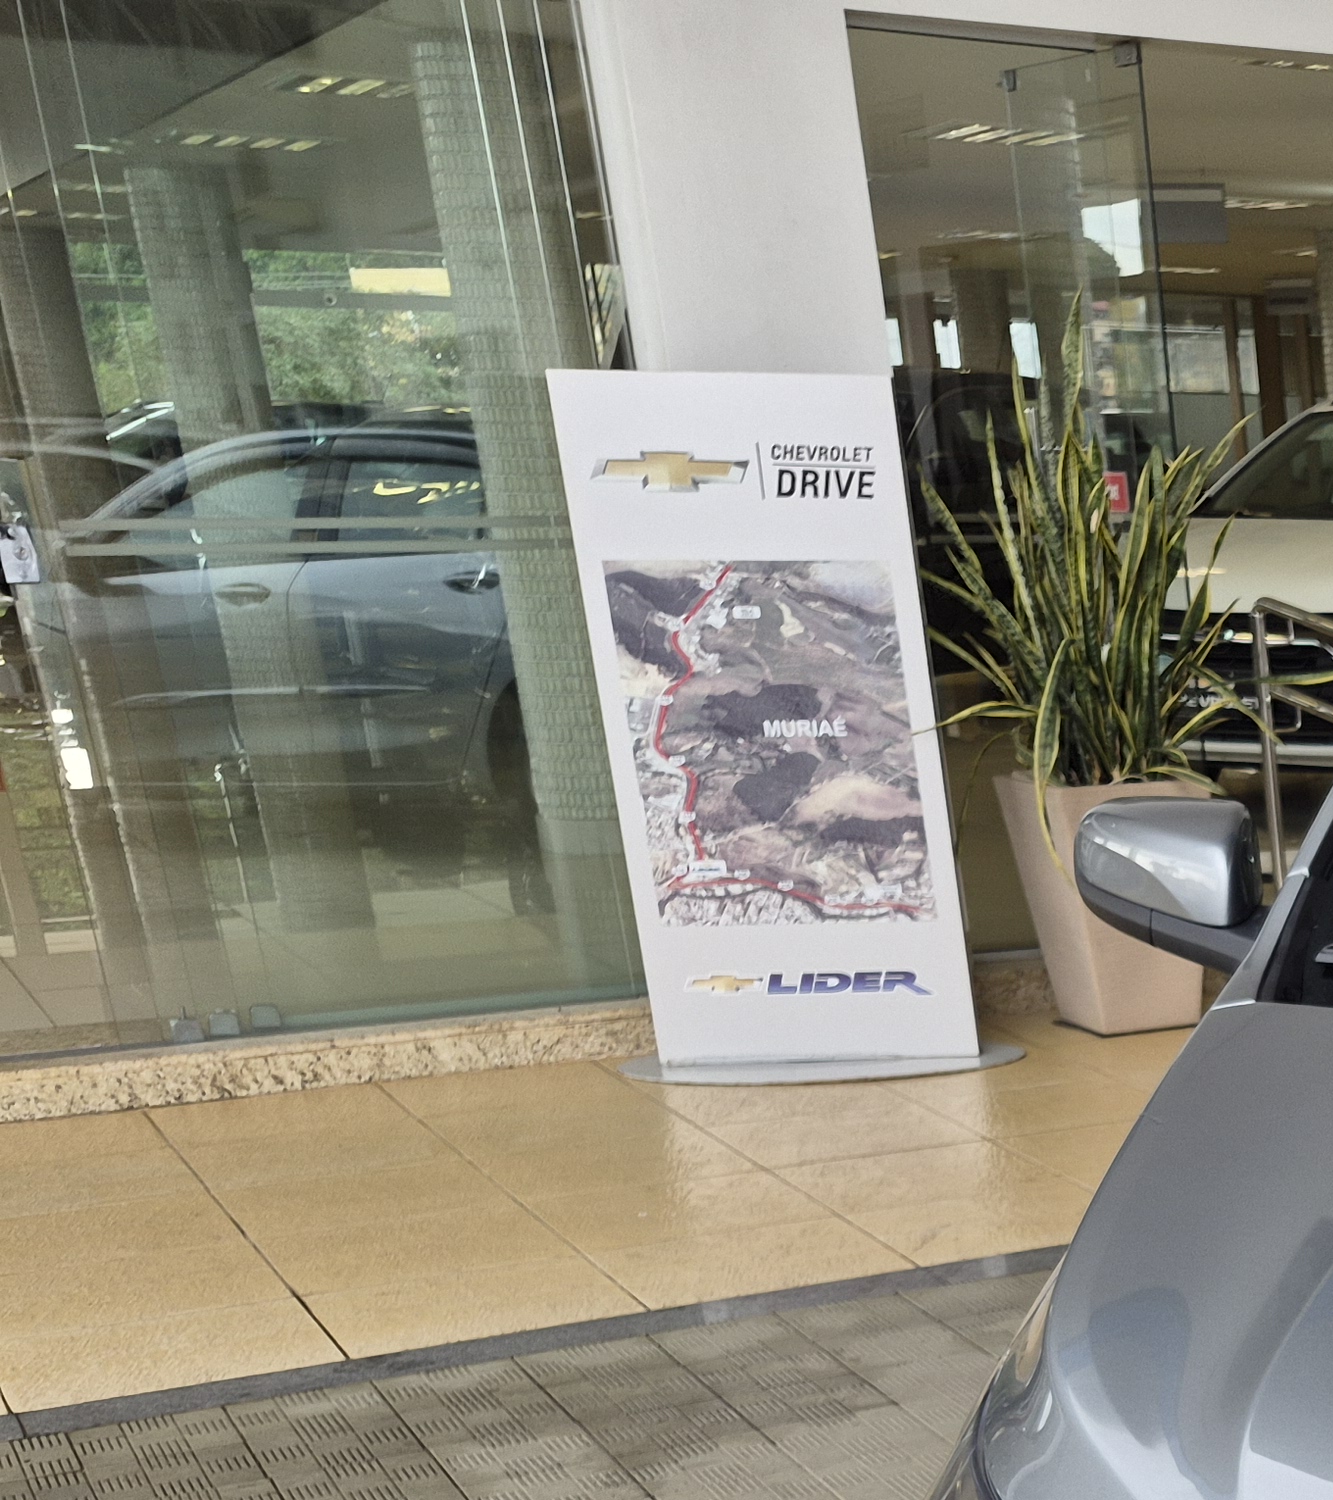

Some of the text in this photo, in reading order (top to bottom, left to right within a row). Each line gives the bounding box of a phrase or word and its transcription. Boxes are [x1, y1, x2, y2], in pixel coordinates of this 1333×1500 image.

[770, 444, 874, 462] CHEVROLET
[776, 469, 876, 499] DRIVE
[762, 714, 848, 738] MURIAÉ
[766, 971, 933, 996] LIDER
